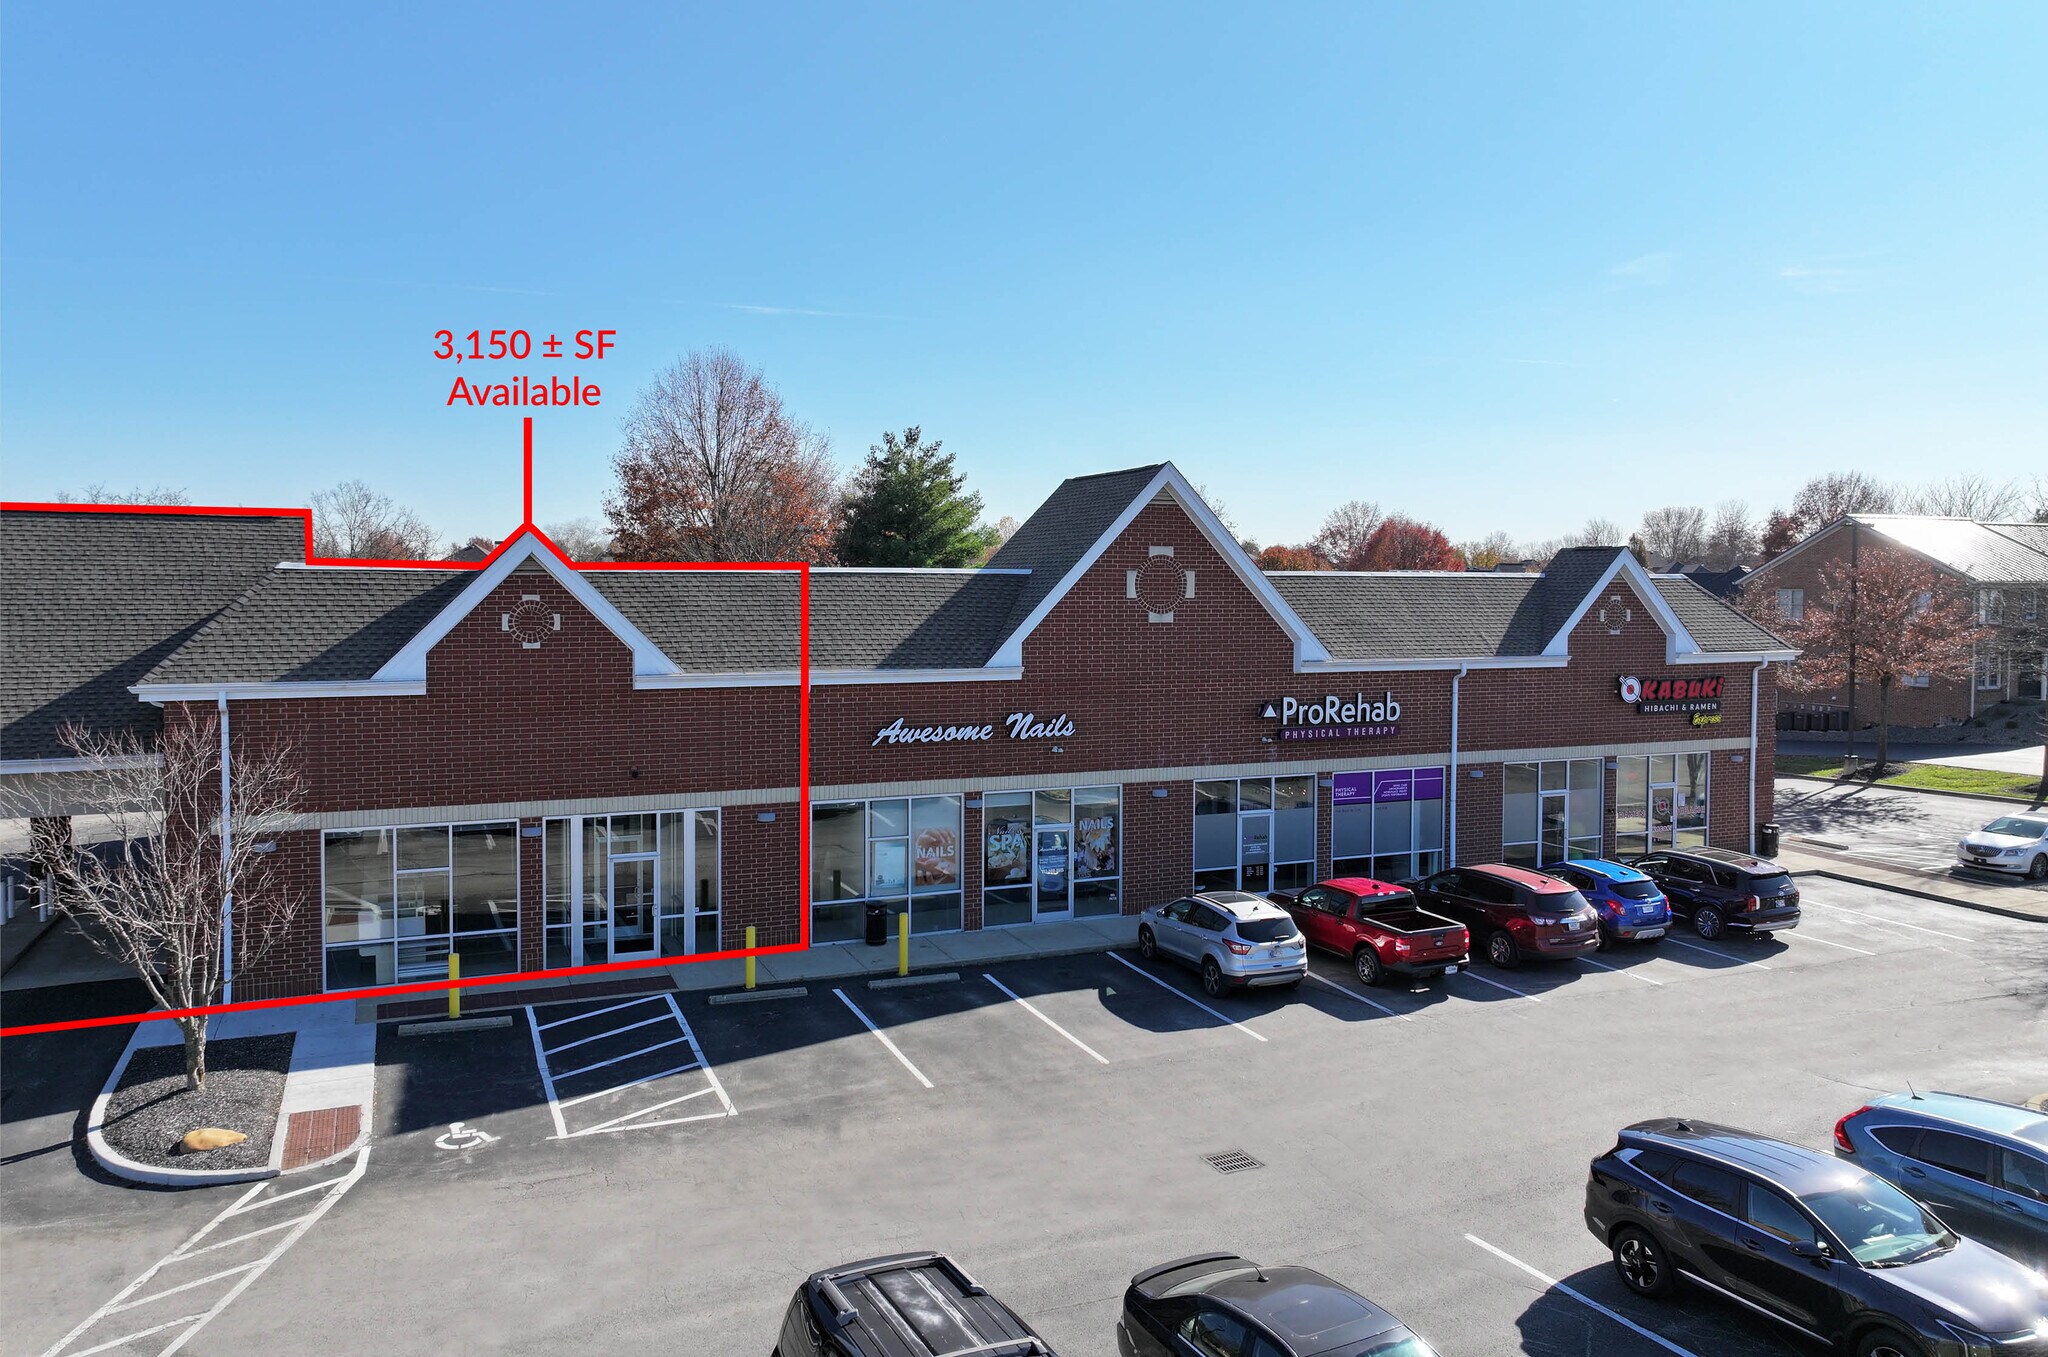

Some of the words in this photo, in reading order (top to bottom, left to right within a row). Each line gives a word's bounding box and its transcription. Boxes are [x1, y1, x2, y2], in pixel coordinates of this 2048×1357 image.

[1282, 691, 1401, 725] ProRehab
[1644, 704, 1679, 712] HIBACHI
[871, 717, 994, 747] Awesome
[1005, 712, 1076, 740] Nails
[1284, 728, 1341, 740] PHYSICAL
[1347, 726, 1396, 736] THERAPY
[1079, 817, 1115, 831] NAILS
[989, 833, 1026, 851] SPA
[915, 845, 955, 859] NAILS
